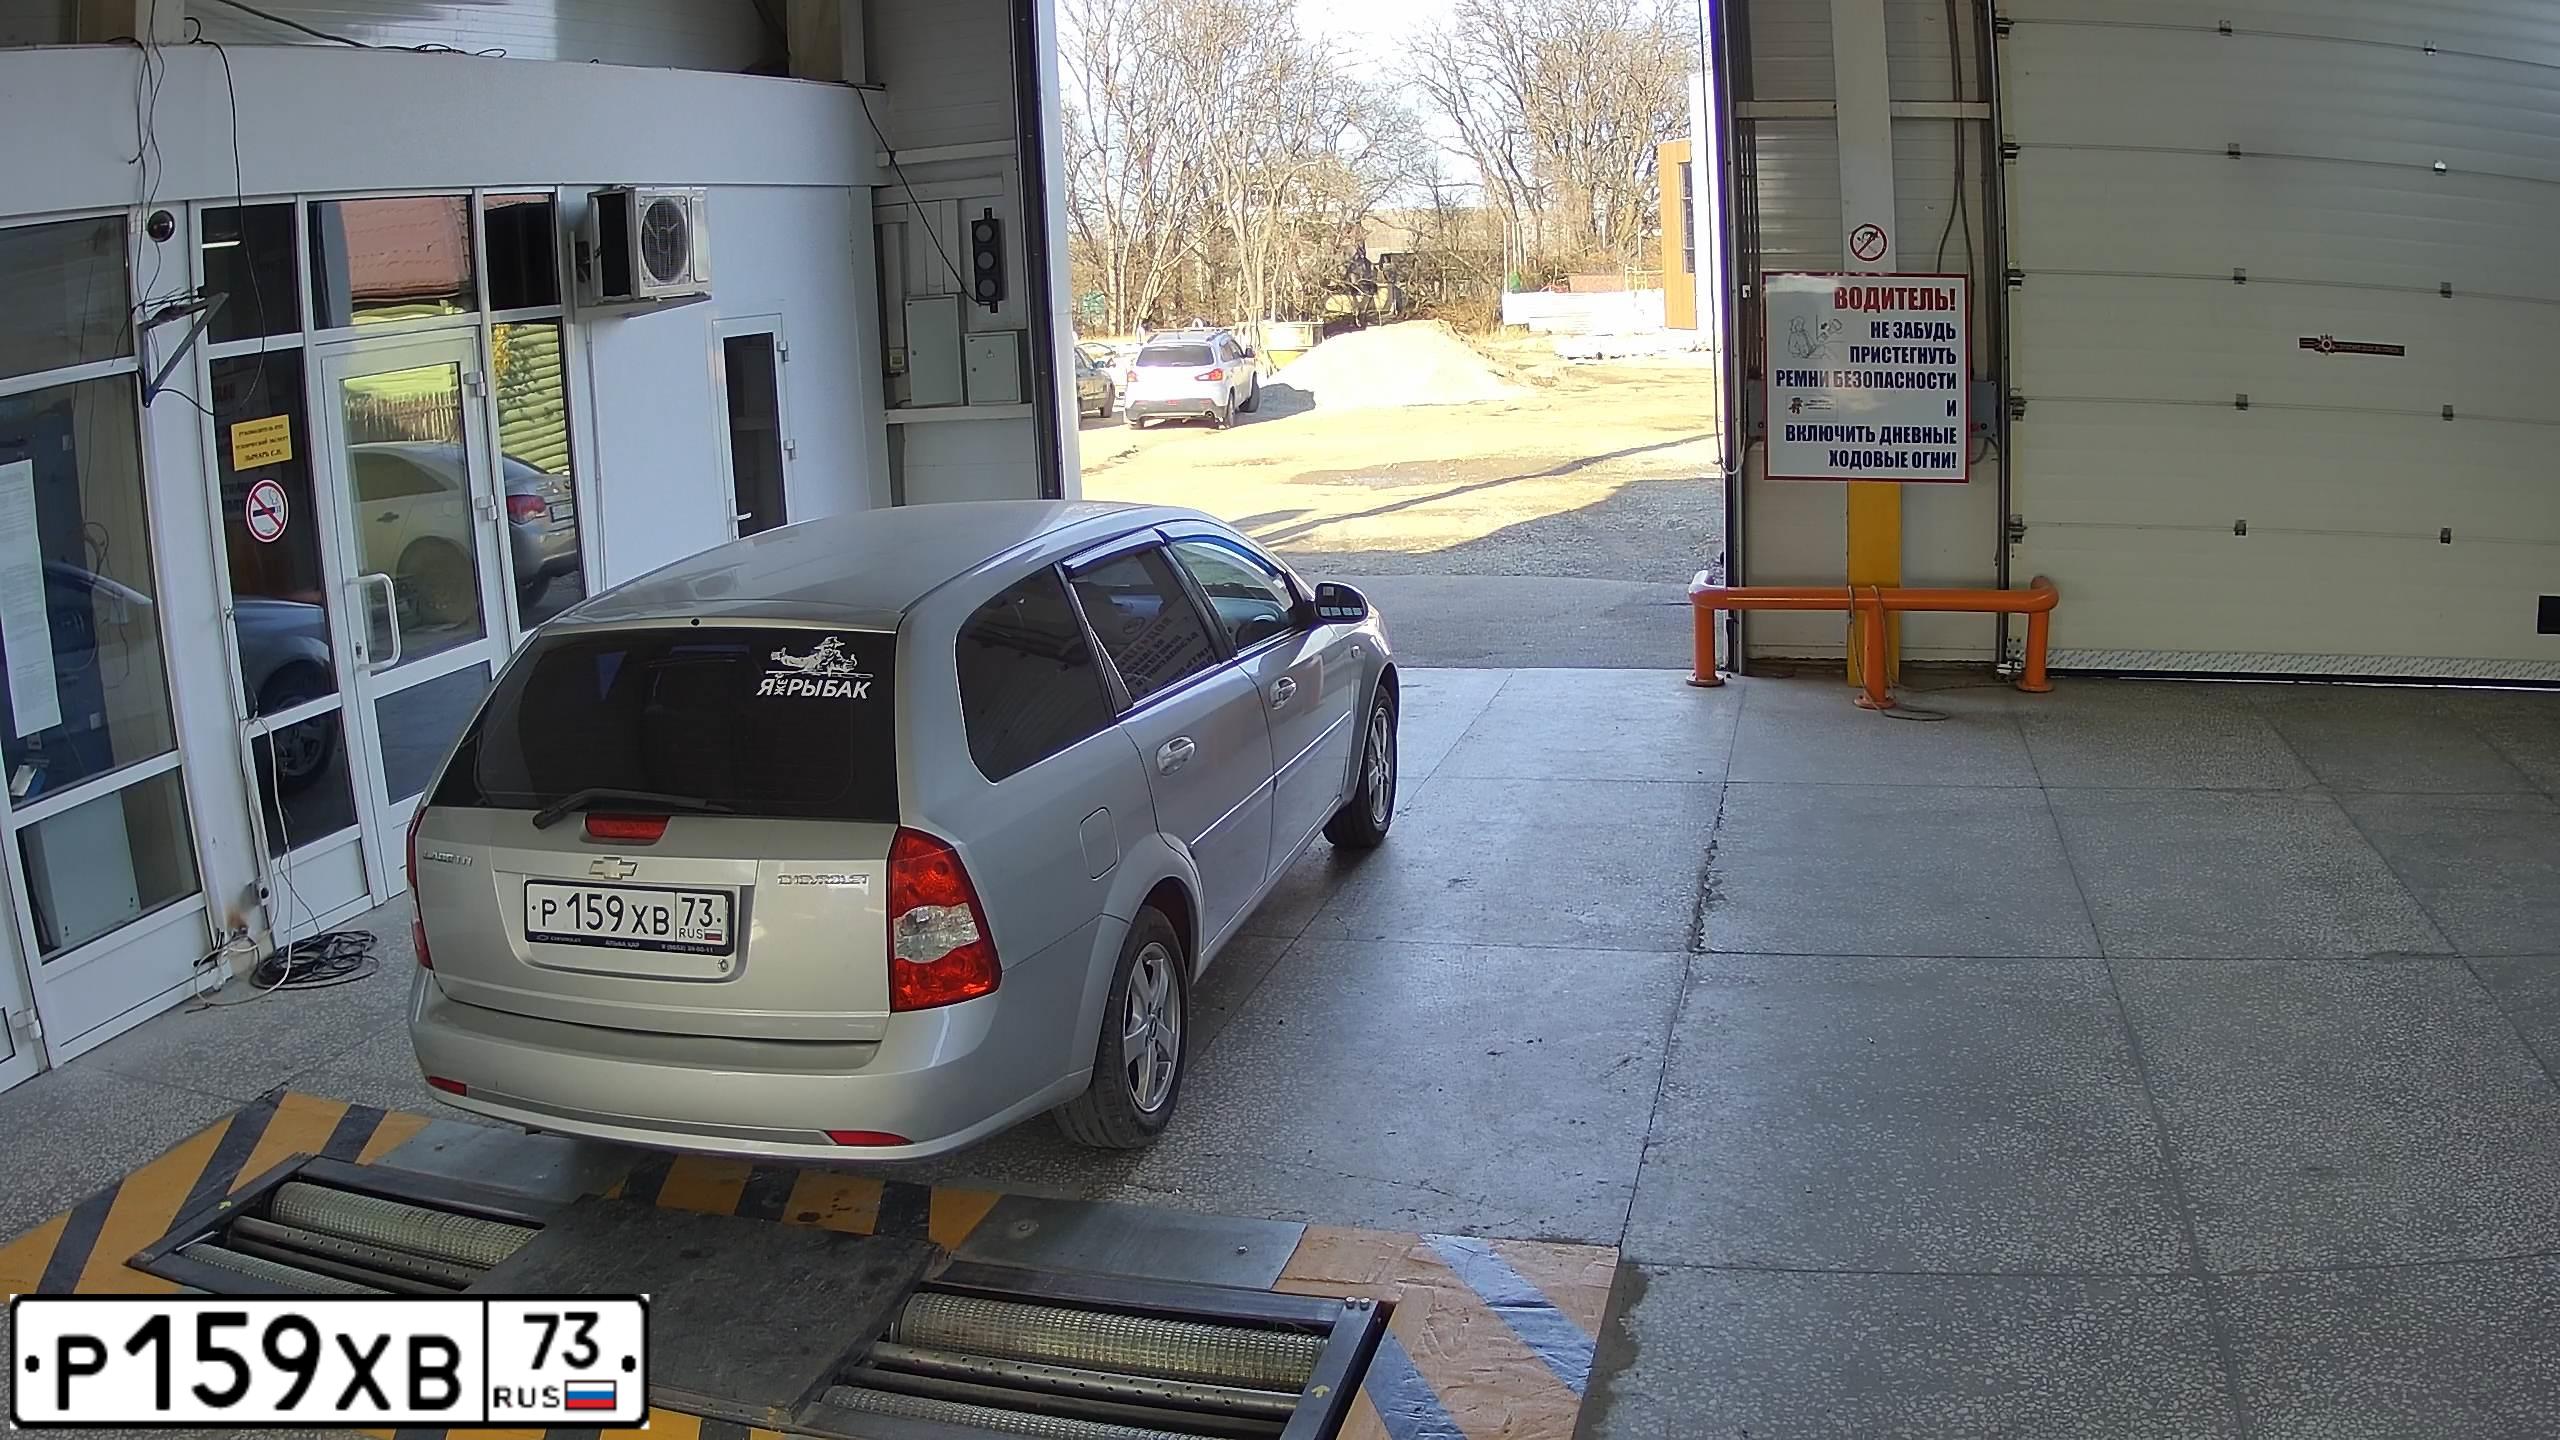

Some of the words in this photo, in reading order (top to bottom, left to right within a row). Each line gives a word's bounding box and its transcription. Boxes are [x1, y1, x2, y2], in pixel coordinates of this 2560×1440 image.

[1834, 286, 1956, 312] ВОДИТЕЛЬ!
[1870, 321, 1891, 339] НЕ
[1893, 321, 1956, 342] ЗАБУДЬ
[1850, 346, 1957, 365] ПРИСТЕГНУТЬ
[1776, 369, 1829, 388] РЕМНИ
[1833, 370, 1957, 390] БЕЗОПАСНОСТИ
[1946, 399, 1957, 417] И
[1785, 425, 1876, 443] ВКЛЮЧИТЬ
[1879, 426, 1957, 447] ДНЕВНЫЕ
[1829, 450, 1909, 470] ХОДОВЫЕ
[1912, 450, 1957, 470] ОГНИ!
[786, 678, 872, 699] РЫБАК
[681, 896, 714, 928] 73
[679, 926, 704, 940] RUS
